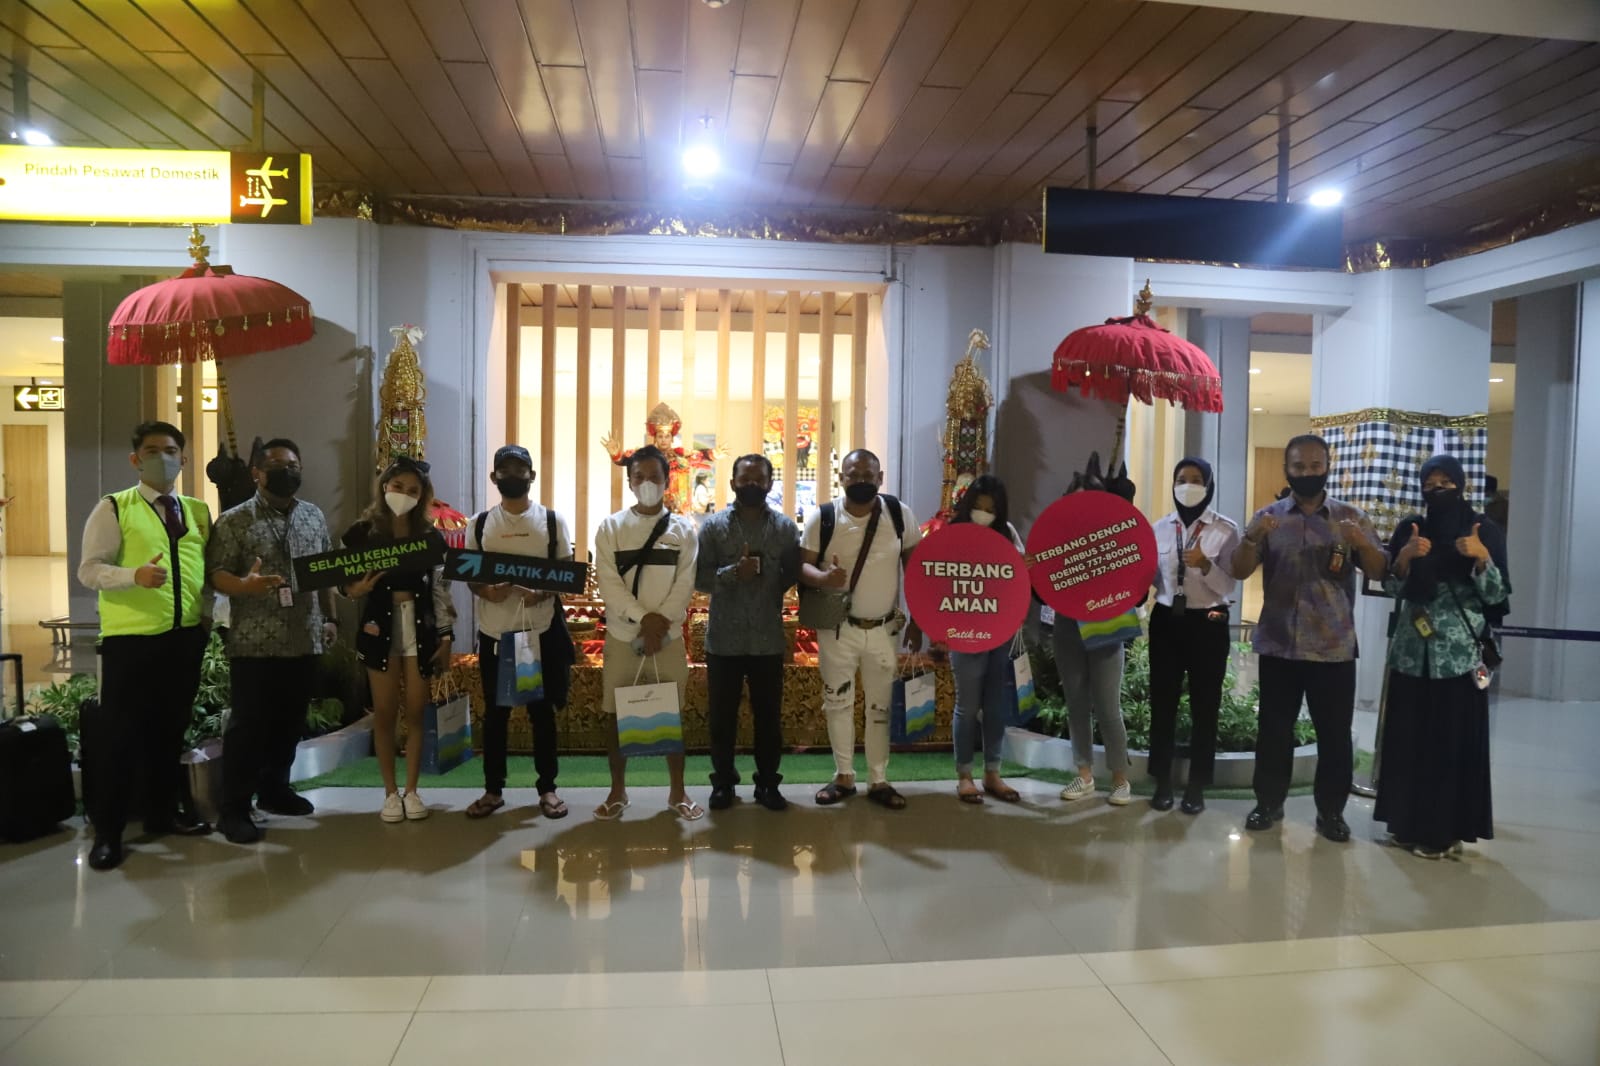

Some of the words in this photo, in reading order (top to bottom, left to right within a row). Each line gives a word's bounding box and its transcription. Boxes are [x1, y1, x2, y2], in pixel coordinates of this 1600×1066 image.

[25, 163, 78, 177] Pindah
[83, 165, 146, 179] Pesawat
[150, 167, 220, 181] Domestik
[1034, 537, 1087, 562] TERBANG
[1088, 517, 1138, 543] DENGAN
[308, 553, 361, 572] SELALU
[363, 540, 428, 561] KENAKAN
[1049, 563, 1086, 582] BOEING
[1087, 543, 1138, 568] 737-800NG
[1063, 547, 1098, 566] AIRBUS
[1100, 540, 1118, 552] 320
[344, 557, 399, 576] MASKER
[494, 563, 543, 579] BATIK
[546, 569, 575, 583] AIR
[921, 561, 1014, 579] TERBANG
[1053, 572, 1090, 591] BOEING
[1091, 553, 1142, 577] 737-900ER
[952, 580, 984, 595] ITU
[939, 597, 998, 613] AMAN
[1086, 594, 1114, 612] Batik
[946, 628, 975, 639] Batik
